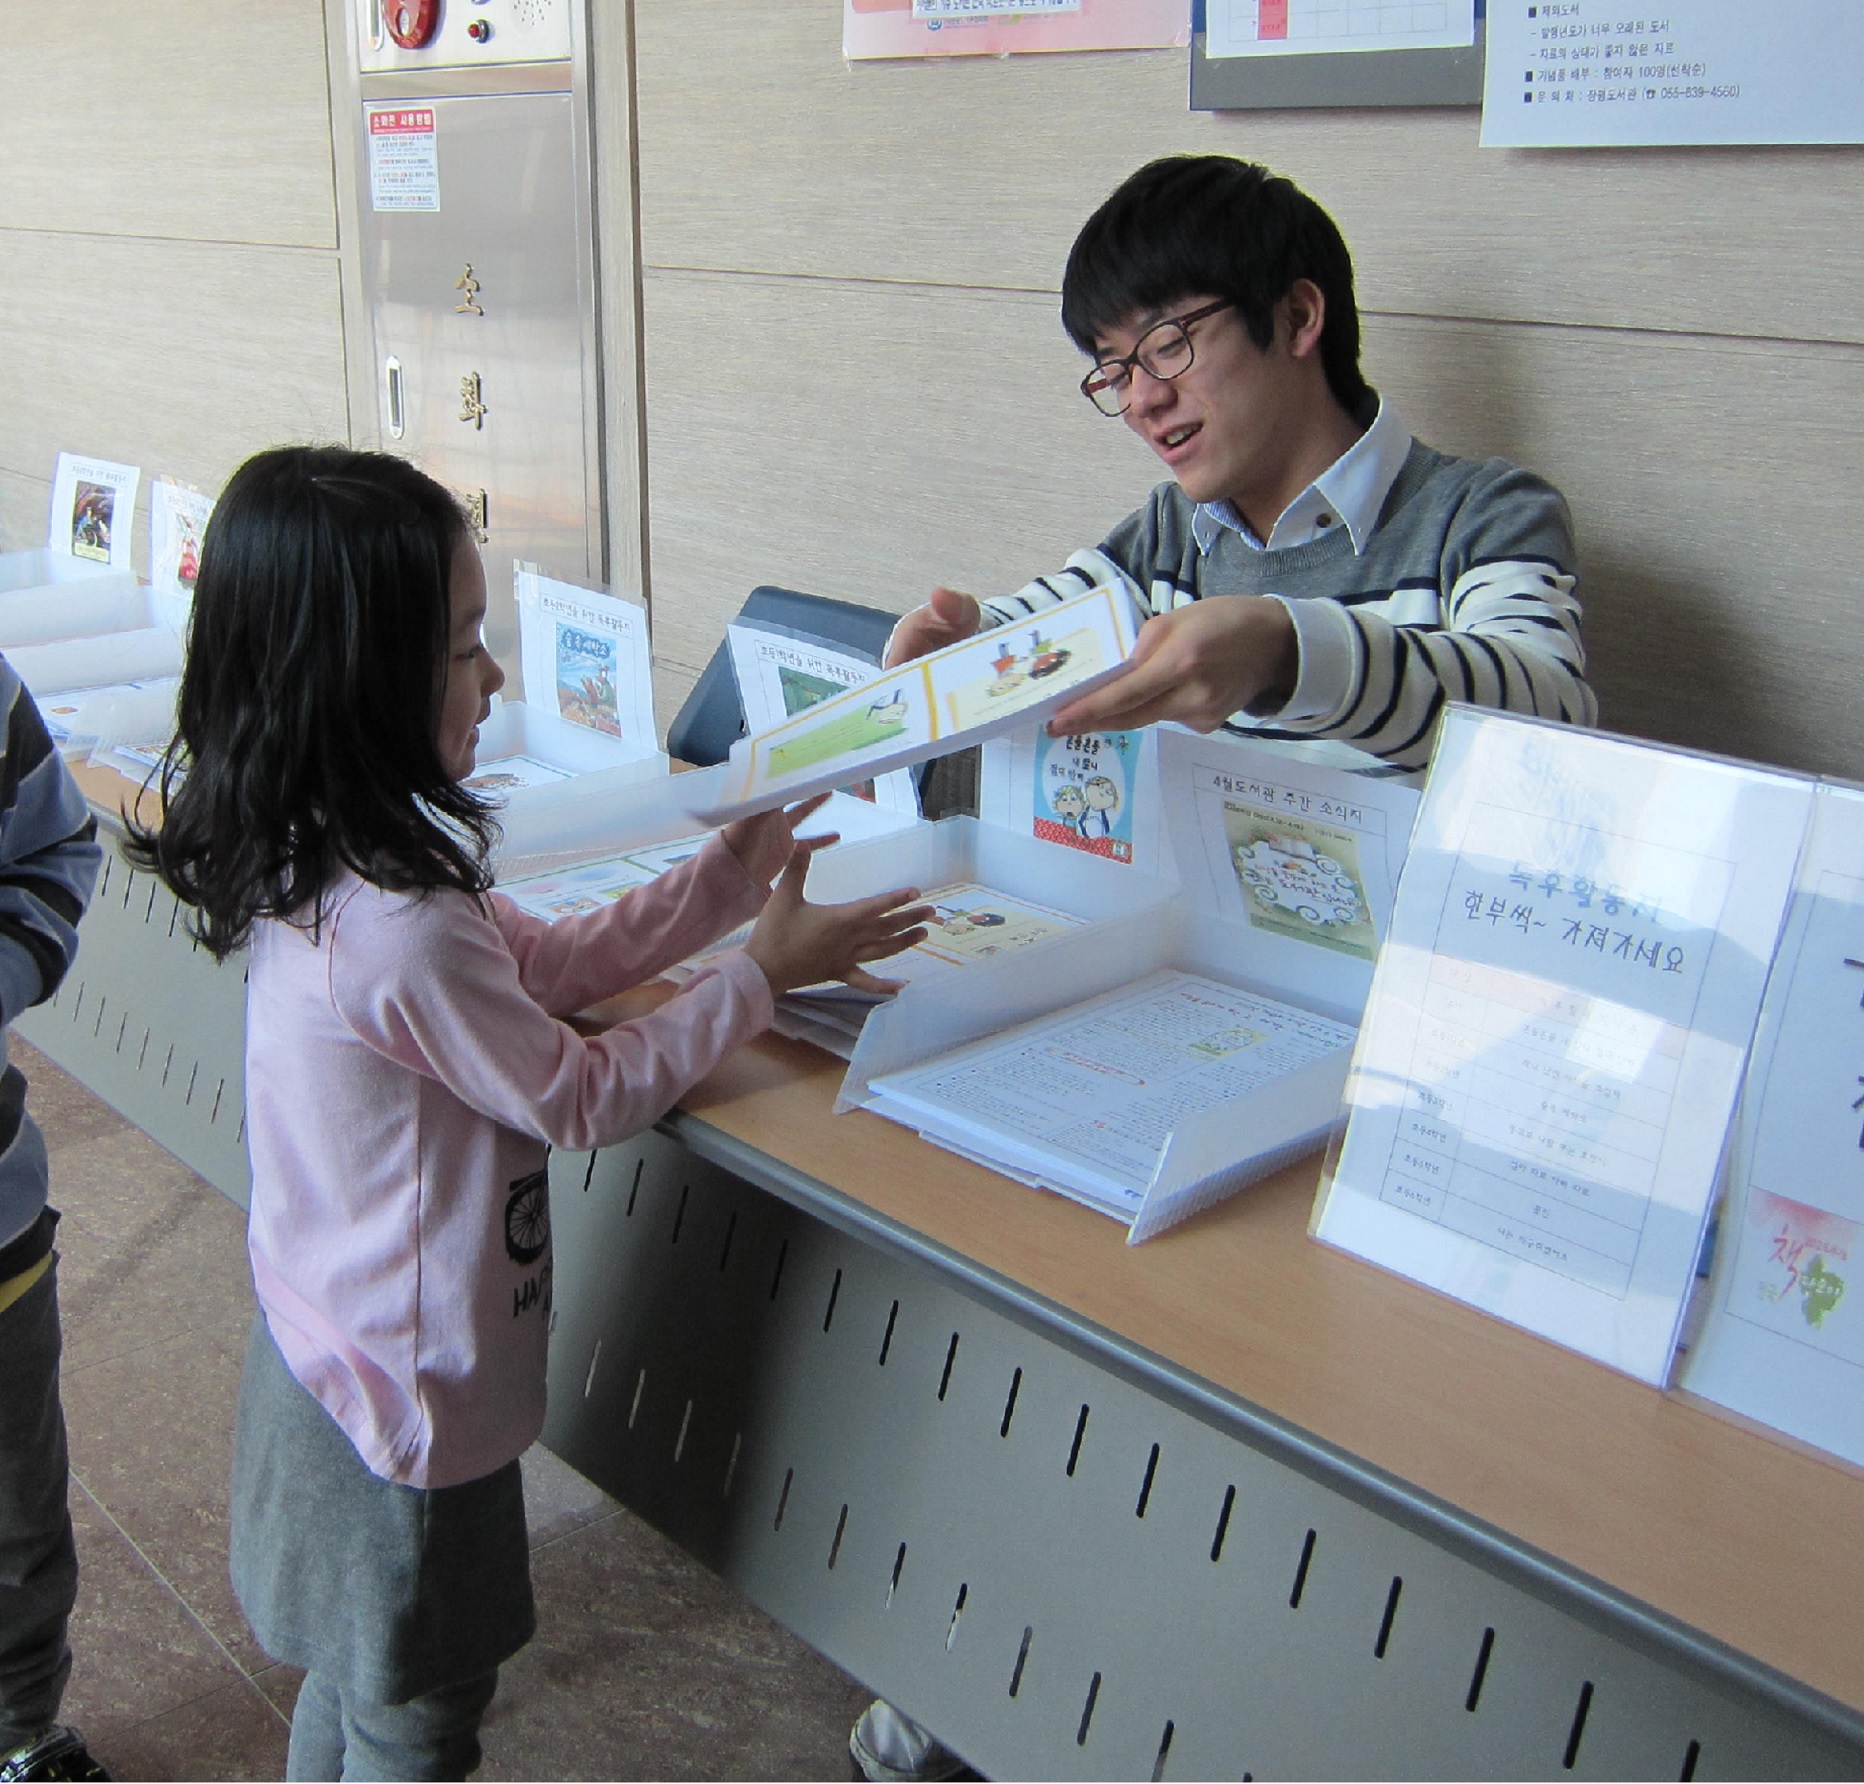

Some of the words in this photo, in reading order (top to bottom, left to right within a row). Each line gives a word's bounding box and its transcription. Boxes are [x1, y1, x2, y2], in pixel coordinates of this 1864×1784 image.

[1591, 23, 1610, 37] 너무
[1616, 21, 1644, 34] 오래된
[1649, 19, 1669, 33] 도서
[1571, 45, 1599, 59] 상태가
[1605, 44, 1624, 58] 좋지
[1628, 43, 1648, 57] 않은
[1654, 42, 1674, 56] 자료
[1213, 776, 1275, 803] 4월도서관
[1283, 791, 1311, 813] 주간
[1320, 801, 1362, 824] 소식지
[1562, 917, 1684, 974] 가져가세요
